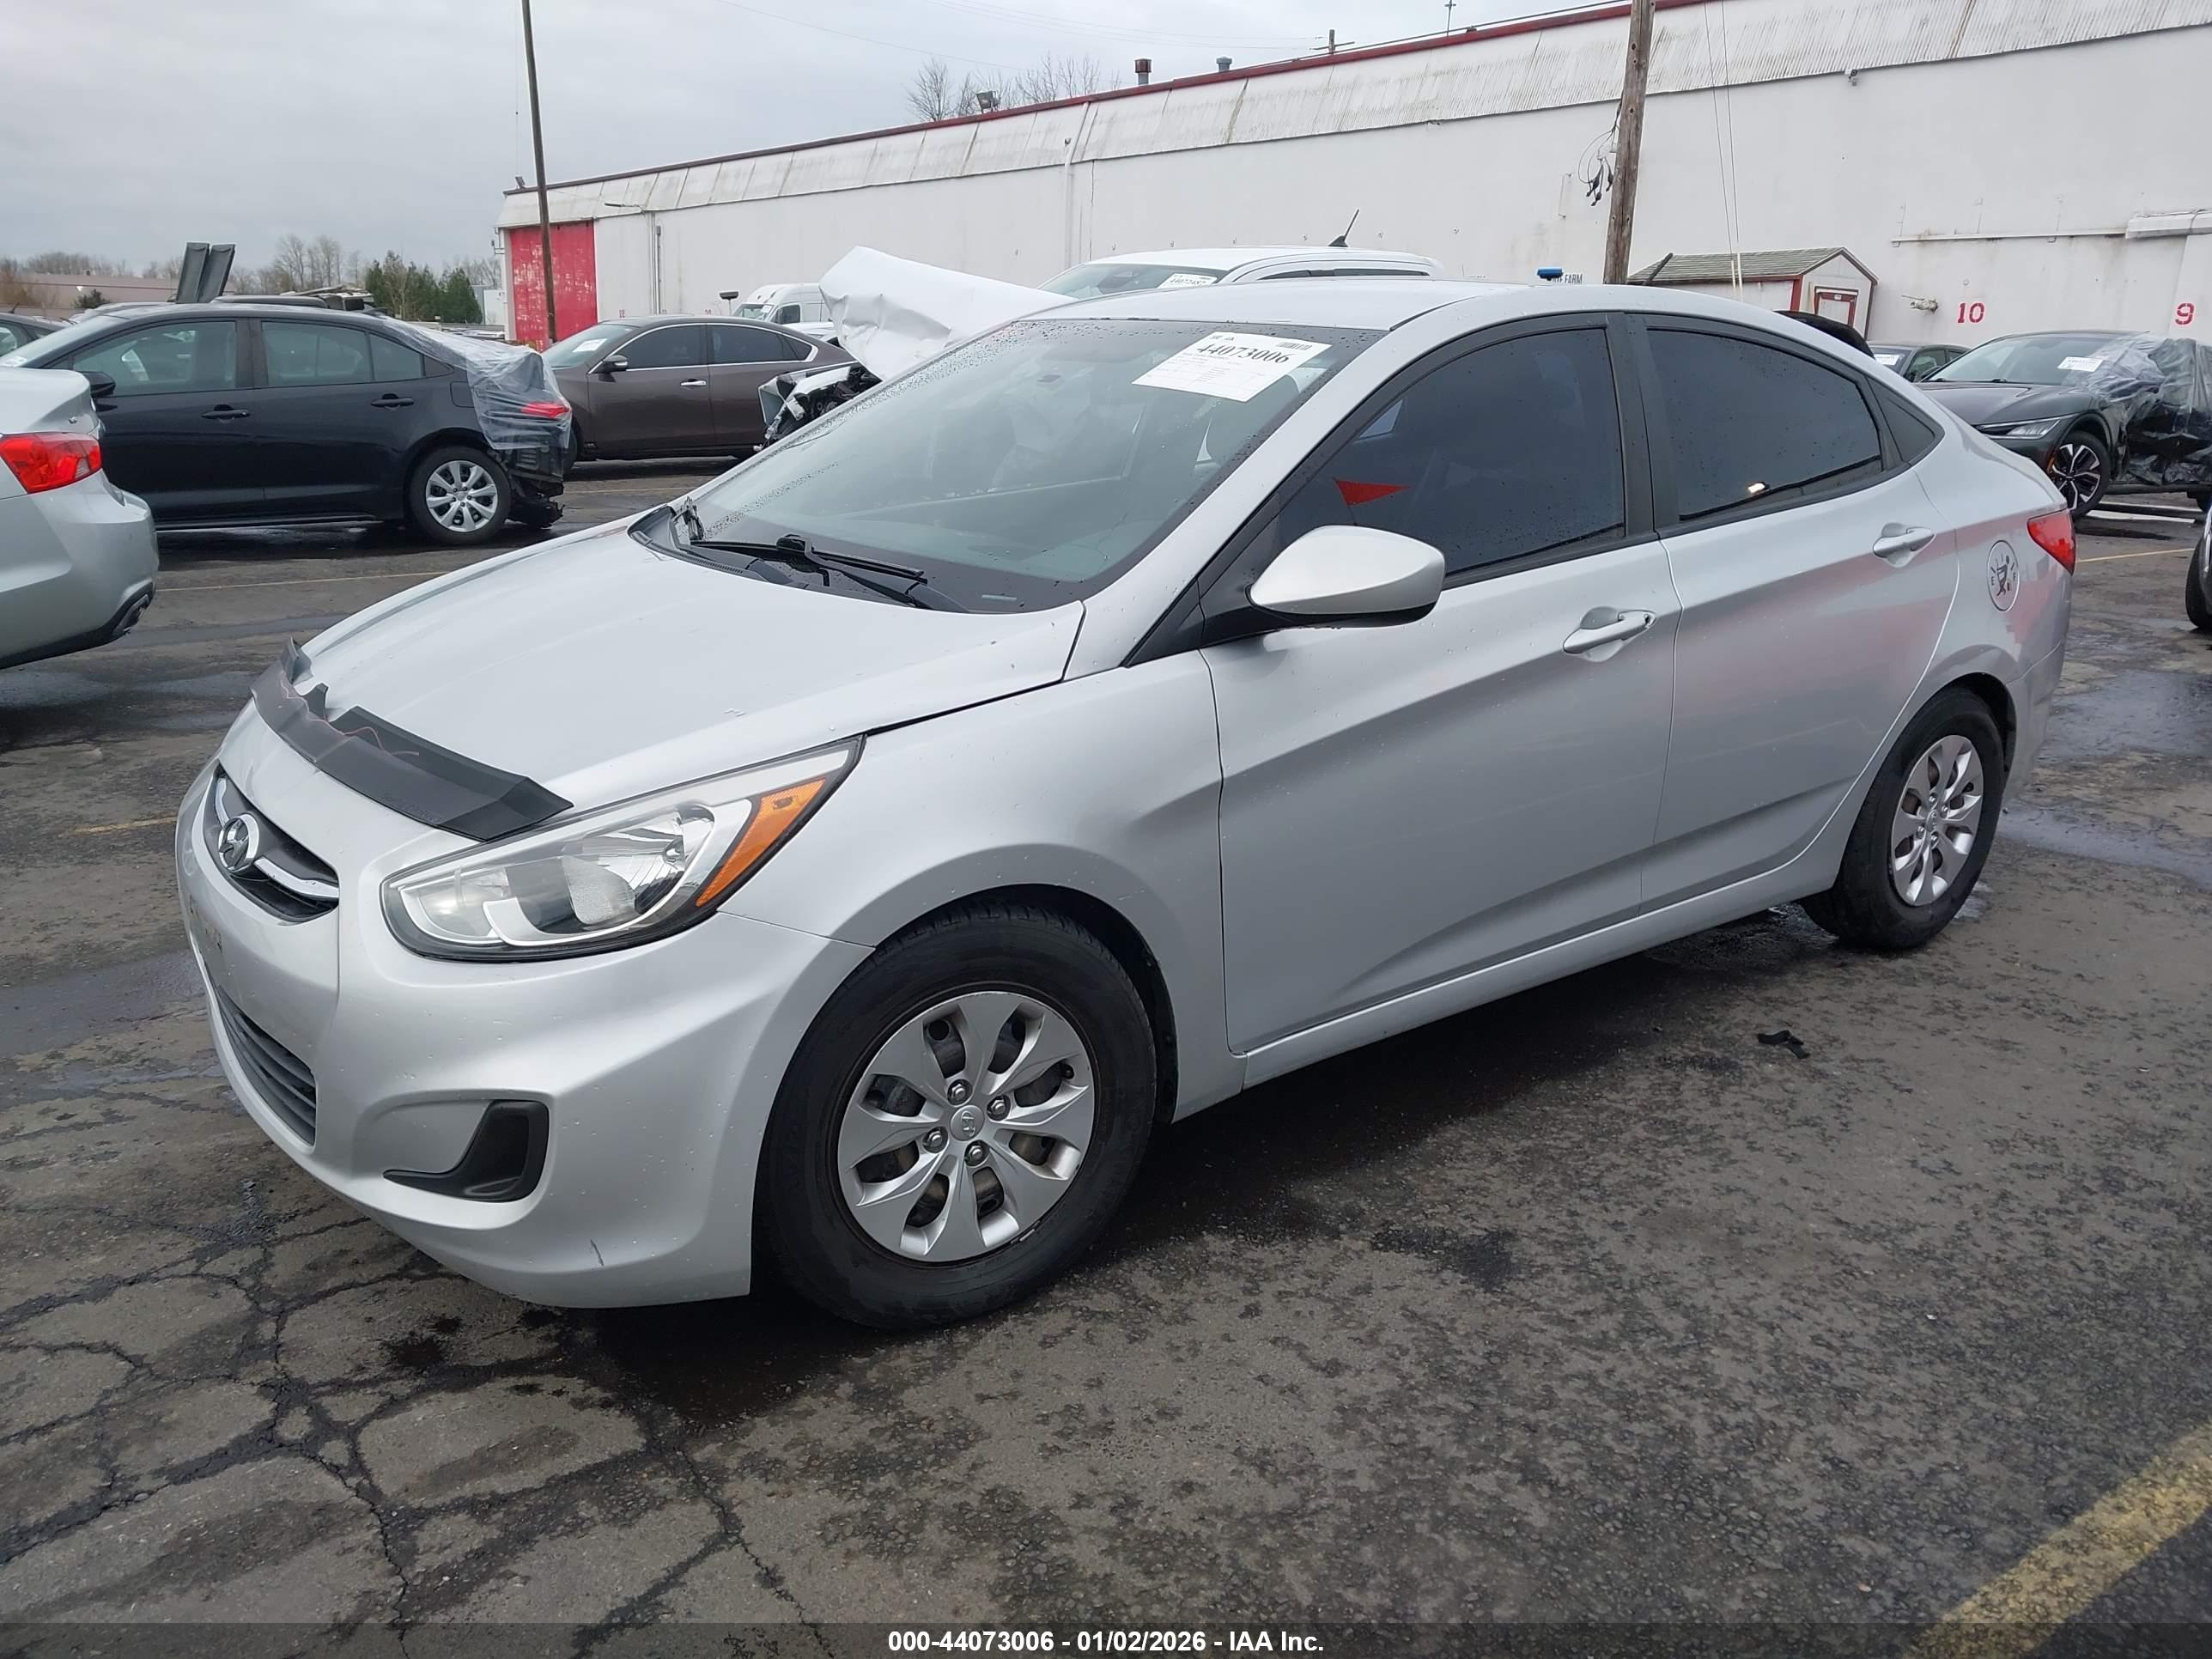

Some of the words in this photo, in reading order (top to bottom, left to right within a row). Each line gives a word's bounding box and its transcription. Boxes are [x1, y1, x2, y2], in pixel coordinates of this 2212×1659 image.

[1957, 302, 1985, 324] 10
[2175, 302, 2195, 325] 9
[1197, 343, 1291, 364] 44073006
